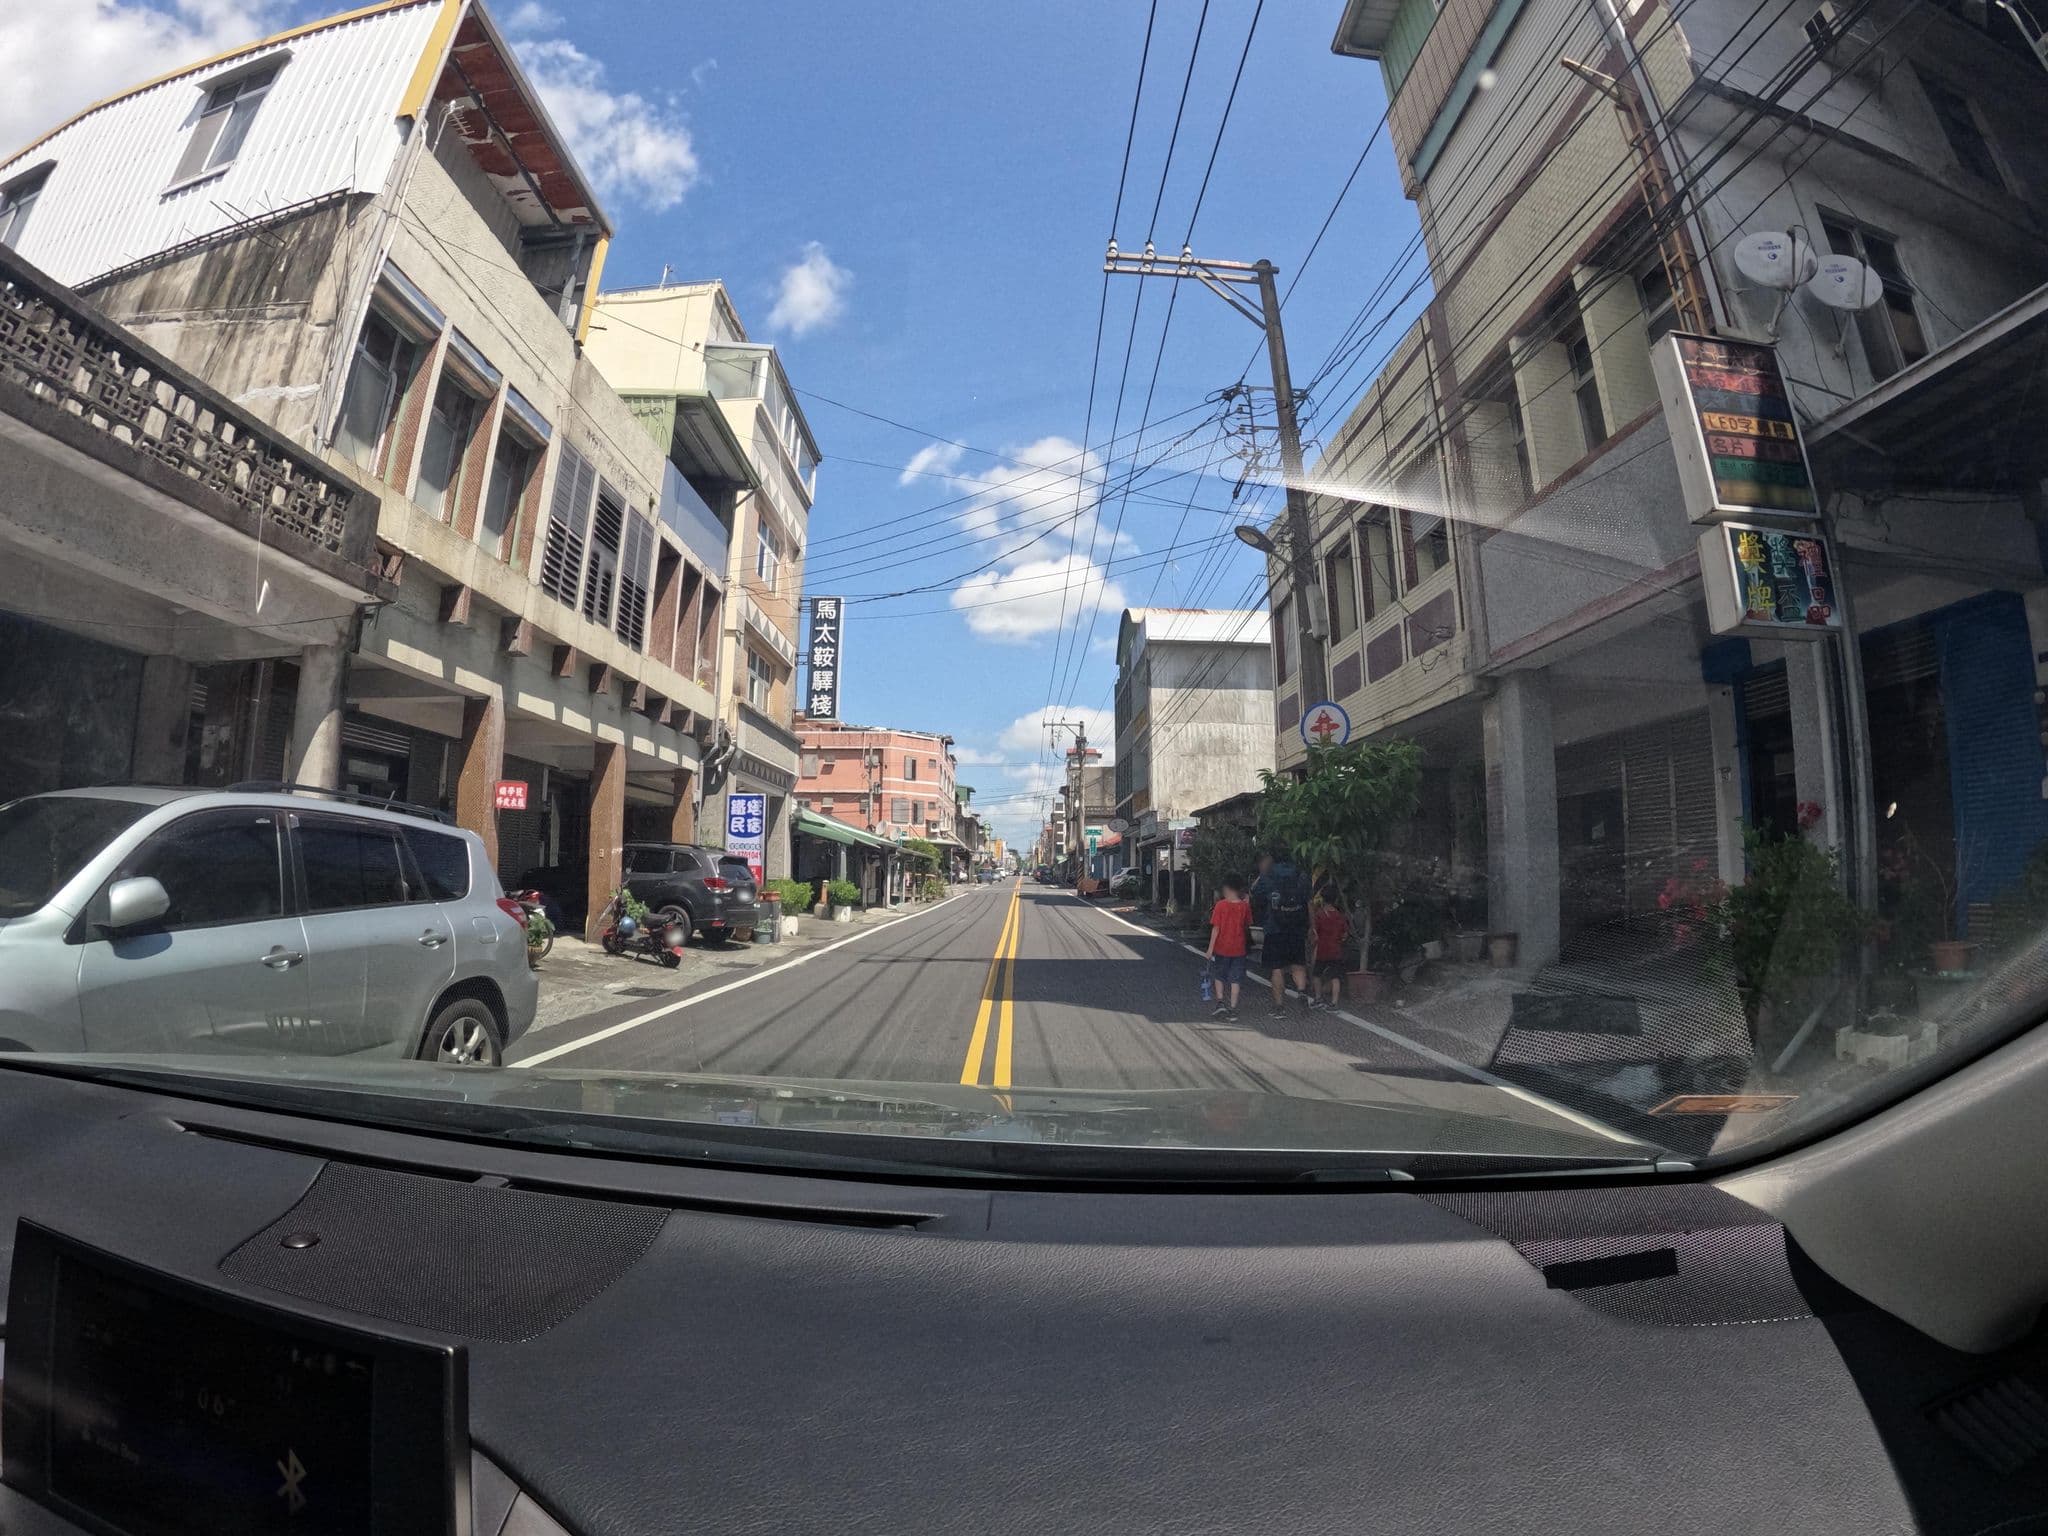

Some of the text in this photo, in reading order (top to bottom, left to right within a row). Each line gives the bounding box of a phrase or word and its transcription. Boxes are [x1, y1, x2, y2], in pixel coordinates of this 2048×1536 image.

[811, 600, 836, 715] 馬太鞍驛棧
[730, 799, 763, 816] 鐵塔
[730, 817, 762, 833] 民宿
